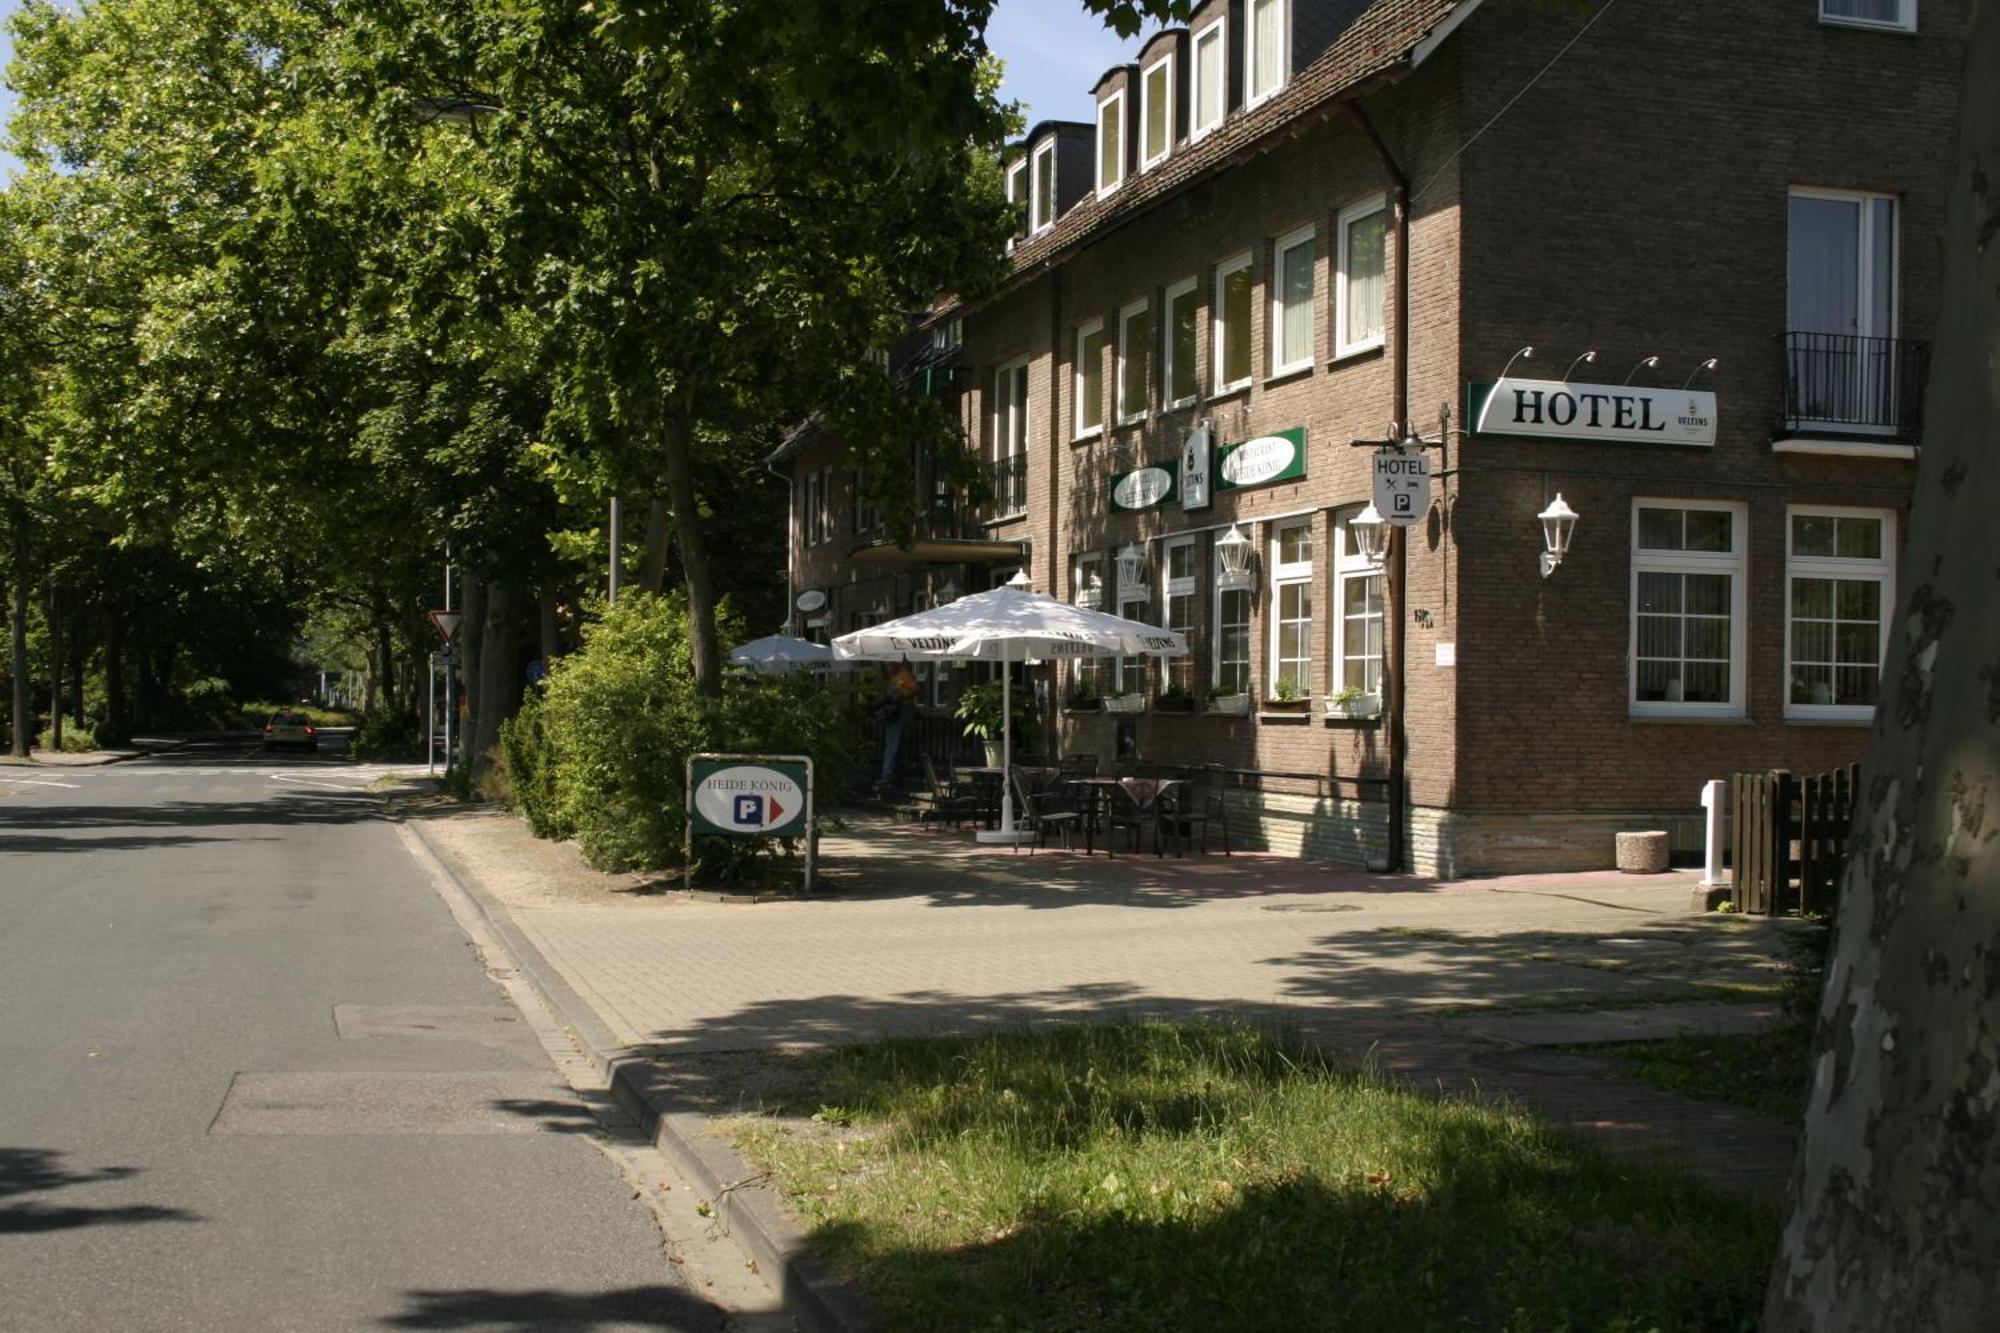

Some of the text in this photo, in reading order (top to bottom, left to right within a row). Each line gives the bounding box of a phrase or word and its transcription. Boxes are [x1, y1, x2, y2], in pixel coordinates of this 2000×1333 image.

[1512, 389, 1666, 431] HOTEL
[1377, 459, 1427, 475] HOTEL
[907, 637, 956, 649] VELTINS
[707, 779, 793, 792] HEIDE KÖNIG
[740, 799, 757, 819] P
